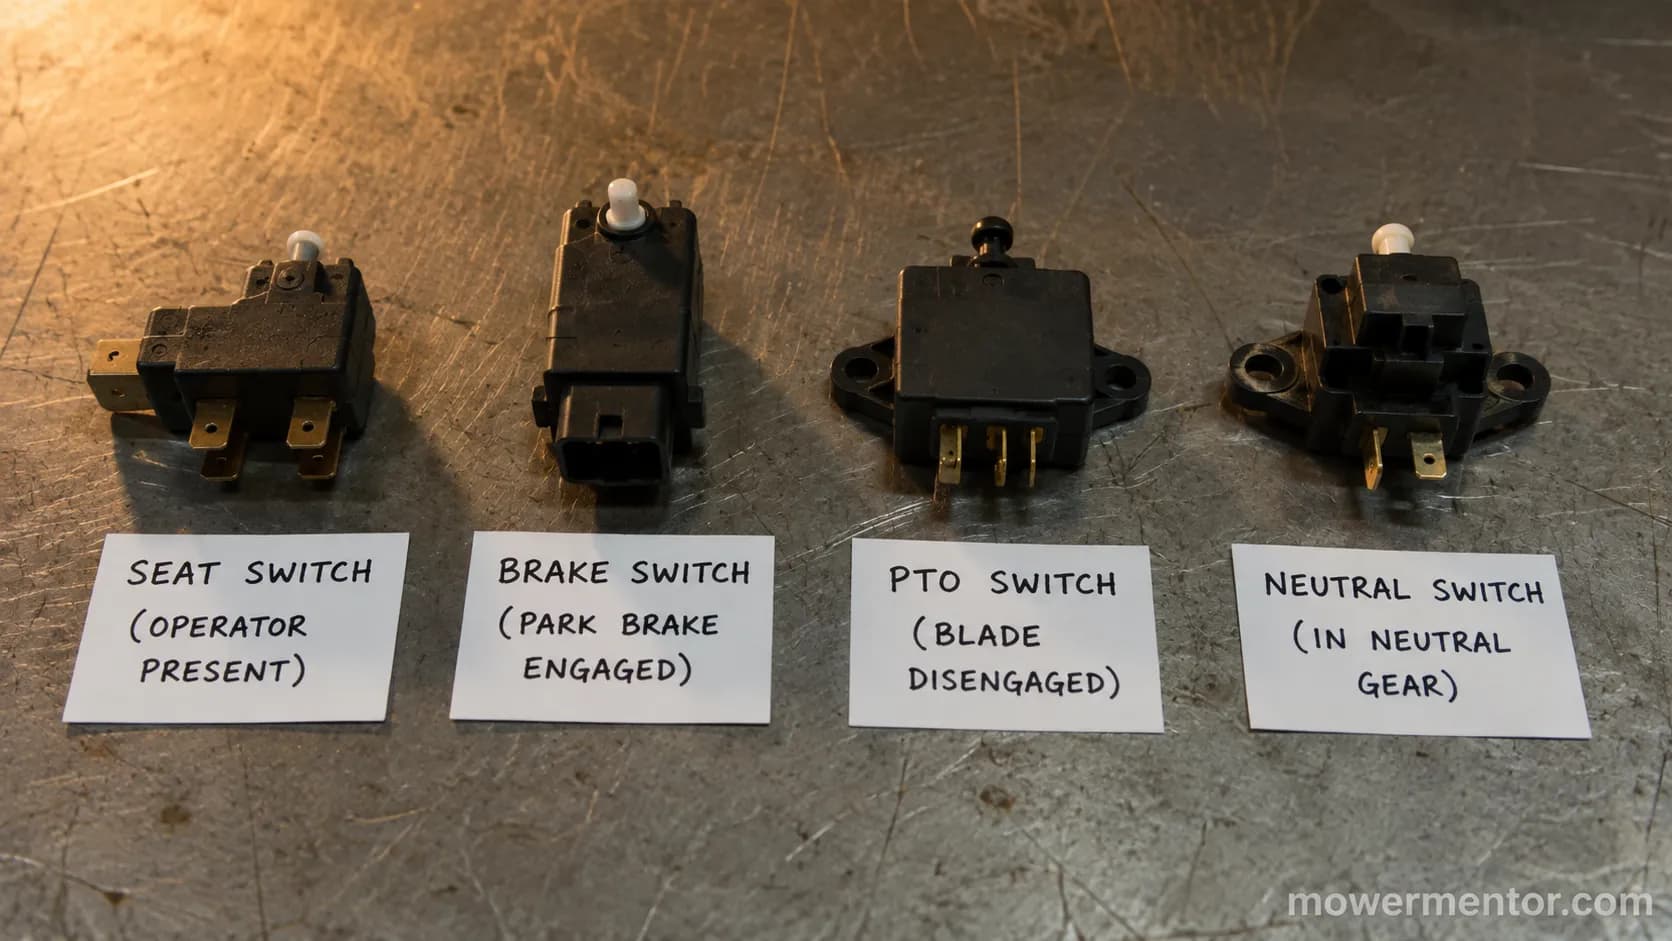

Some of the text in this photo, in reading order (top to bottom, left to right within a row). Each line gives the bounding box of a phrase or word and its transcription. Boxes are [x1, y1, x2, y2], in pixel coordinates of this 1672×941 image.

[127, 558, 373, 586] SEAT SWITCH
[498, 556, 750, 585] BRAKE SWITCH
[889, 565, 1117, 597] PTO SWITCH
[1264, 570, 1545, 605] NEUTRAL SWITCH
[129, 608, 308, 644] (OPERATOR
[498, 605, 719, 641] (PARK BRAKE
[912, 615, 1041, 652] (BLADE
[1293, 619, 1512, 655] (IN NEUTRAL
[139, 652, 306, 688] PRESENT)
[523, 651, 692, 688] ENGAGED)
[908, 665, 1121, 700] DISENGAGED)
[1357, 668, 1458, 704] GEAR)
